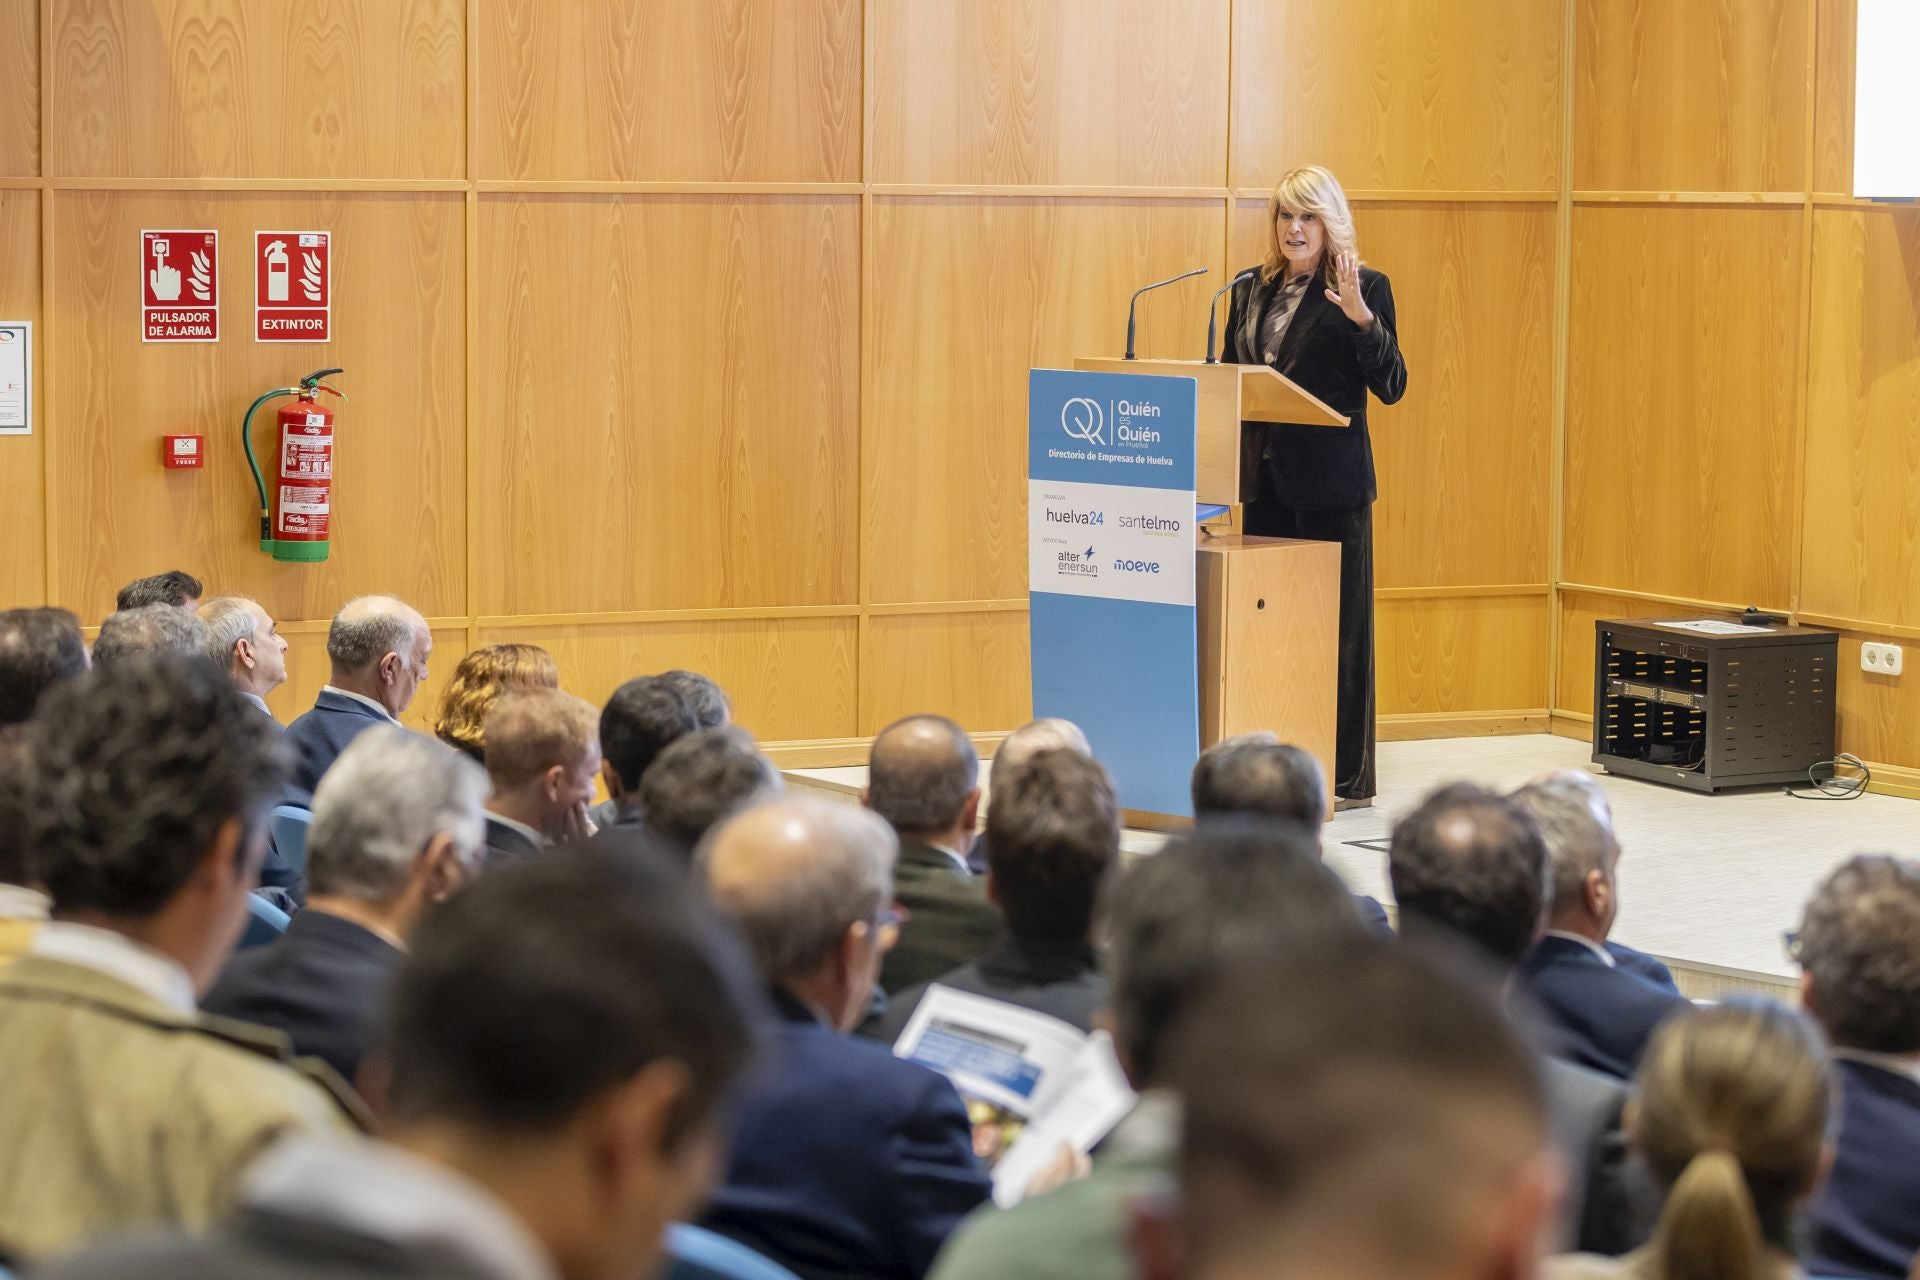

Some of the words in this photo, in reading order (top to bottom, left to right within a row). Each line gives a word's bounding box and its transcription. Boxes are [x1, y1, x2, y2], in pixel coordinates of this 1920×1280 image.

[150, 312, 210, 322] PULSADOR
[149, 326, 164, 336] DE
[166, 325, 212, 336] ALARMA
[262, 319, 323, 330] EXTINTOR
[1118, 400, 1160, 417] Quién
[1119, 416, 1131, 425] es
[1118, 425, 1160, 442] Quién
[1048, 448, 1085, 460] Directorio
[1087, 451, 1096, 460] de
[1098, 452, 1133, 463] Empresas
[1136, 454, 1145, 463] de
[1146, 456, 1173, 466] Huelva
[1046, 507, 1104, 525] huelva24
[1119, 515, 1179, 531] santelmo
[1058, 551, 1080, 562] alter
[1058, 562, 1098, 573] enersun
[1114, 560, 1159, 573] moeve
